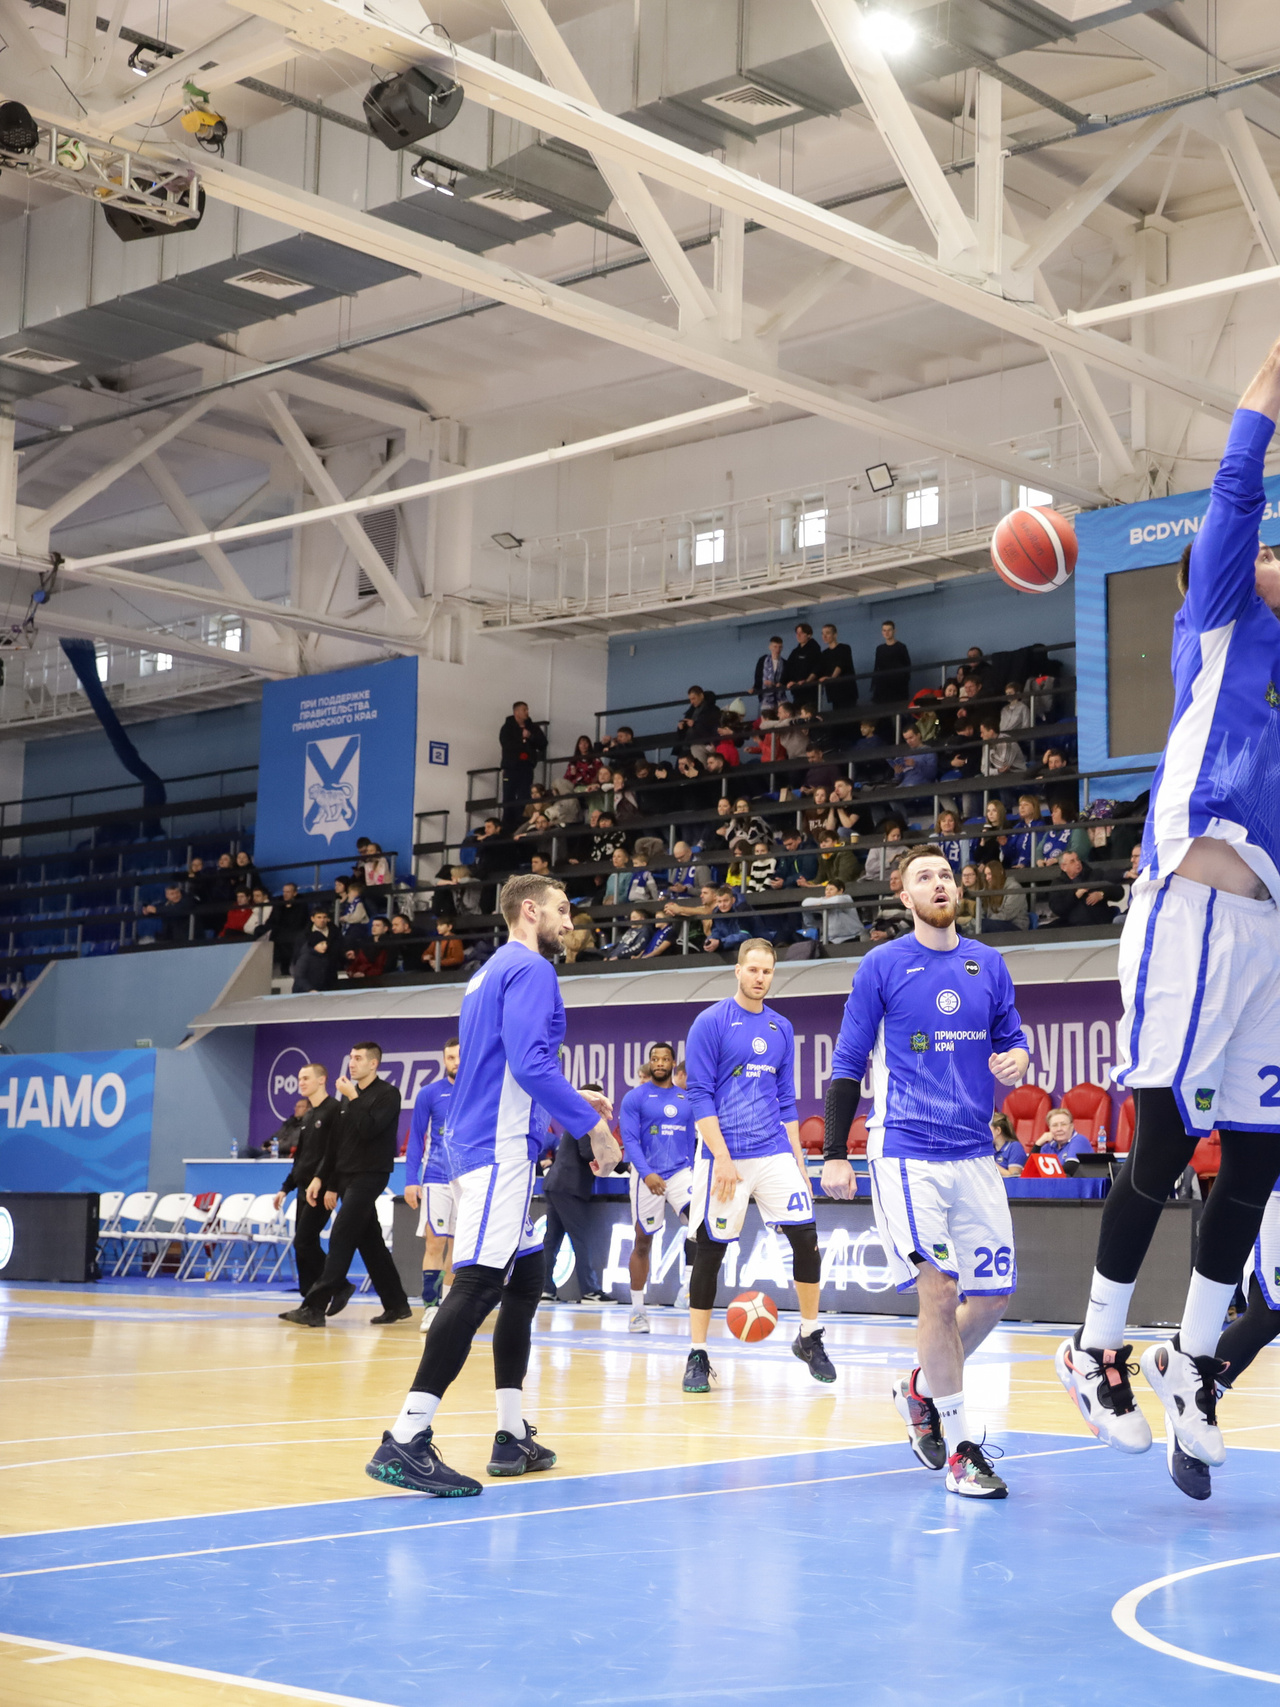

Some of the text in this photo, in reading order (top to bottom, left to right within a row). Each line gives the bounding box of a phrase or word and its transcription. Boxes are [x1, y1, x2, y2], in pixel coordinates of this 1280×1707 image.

[300, 689, 371, 710] ПРИ ПОДДЕРЖКЕ
[300, 701, 370, 720] ПРАВИТЕЛЬСТВА
[292, 710, 378, 732] ПРИМОРСКОГО КРАЯ
[934, 1029, 987, 1041] ПРИМОРСКИЙ
[935, 1040, 955, 1052] КРАЙ
[274, 1074, 300, 1096] РФ
[786, 1192, 811, 1212] 41
[973, 1246, 1011, 1278] 26
